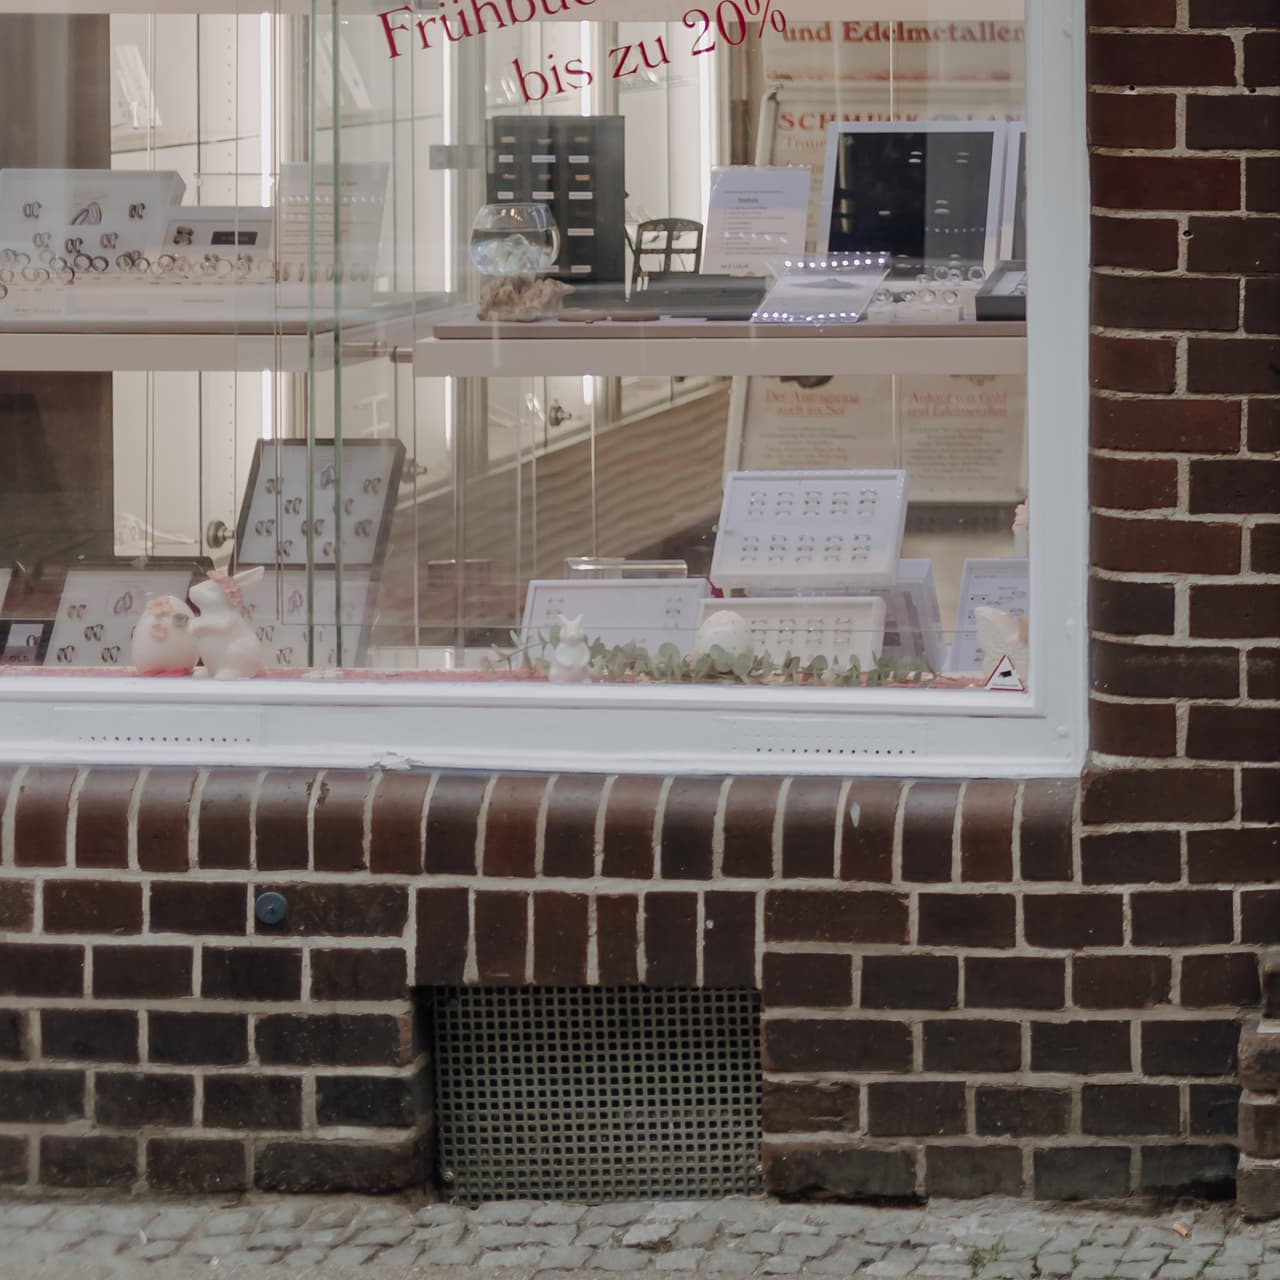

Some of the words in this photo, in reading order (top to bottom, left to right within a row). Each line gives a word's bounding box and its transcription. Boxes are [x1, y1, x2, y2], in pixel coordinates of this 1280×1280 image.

[783, 21, 832, 42] und
[512, 53, 593, 104] bis
[608, 35, 671, 79] zu
